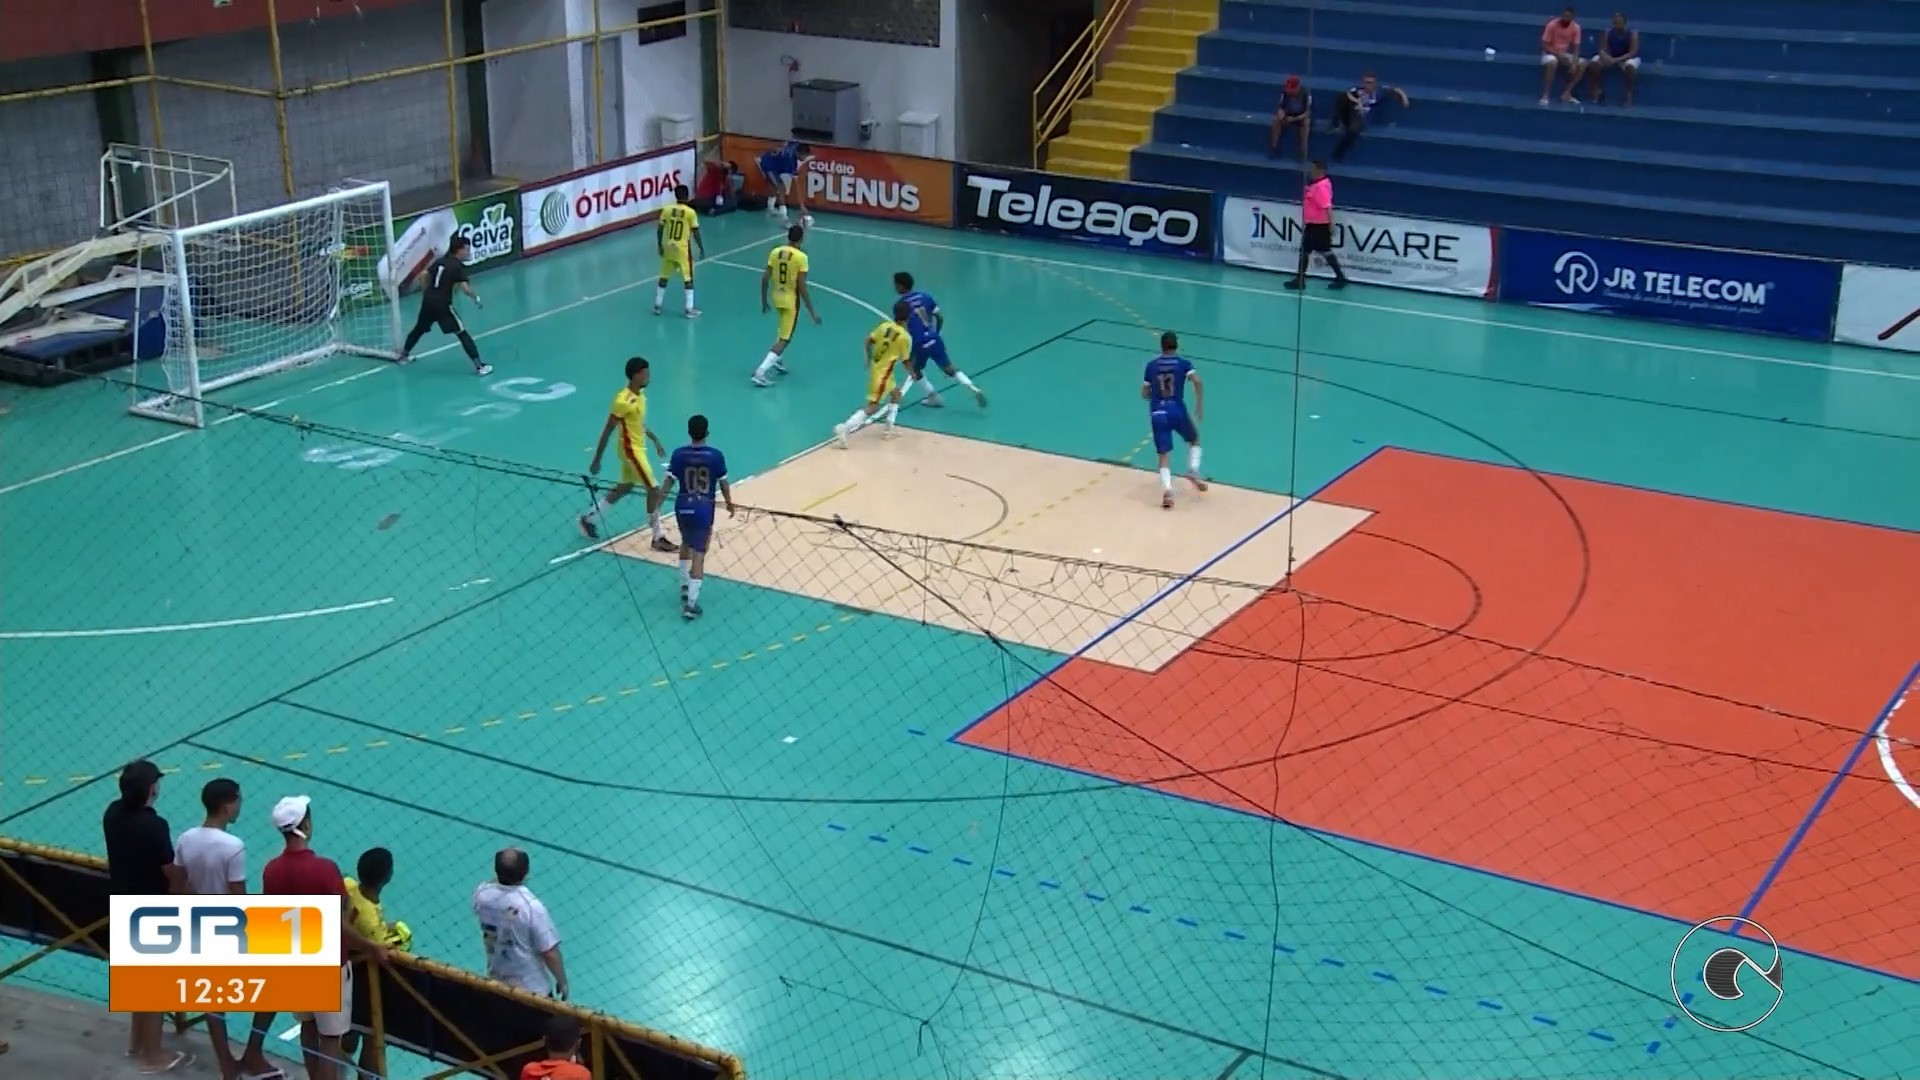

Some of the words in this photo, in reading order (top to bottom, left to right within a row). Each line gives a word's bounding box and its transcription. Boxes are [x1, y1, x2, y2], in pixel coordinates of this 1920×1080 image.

[808, 158, 855, 175] COLÉGIO
[806, 171, 921, 213] PLENUS
[965, 174, 1199, 247] Teleaço
[668, 219, 684, 242] 10
[434, 264, 445, 289] 1
[779, 262, 789, 285] 8
[1603, 267, 1636, 290] JR
[1642, 271, 1767, 305] TELECOM
[684, 466, 711, 495] 09
